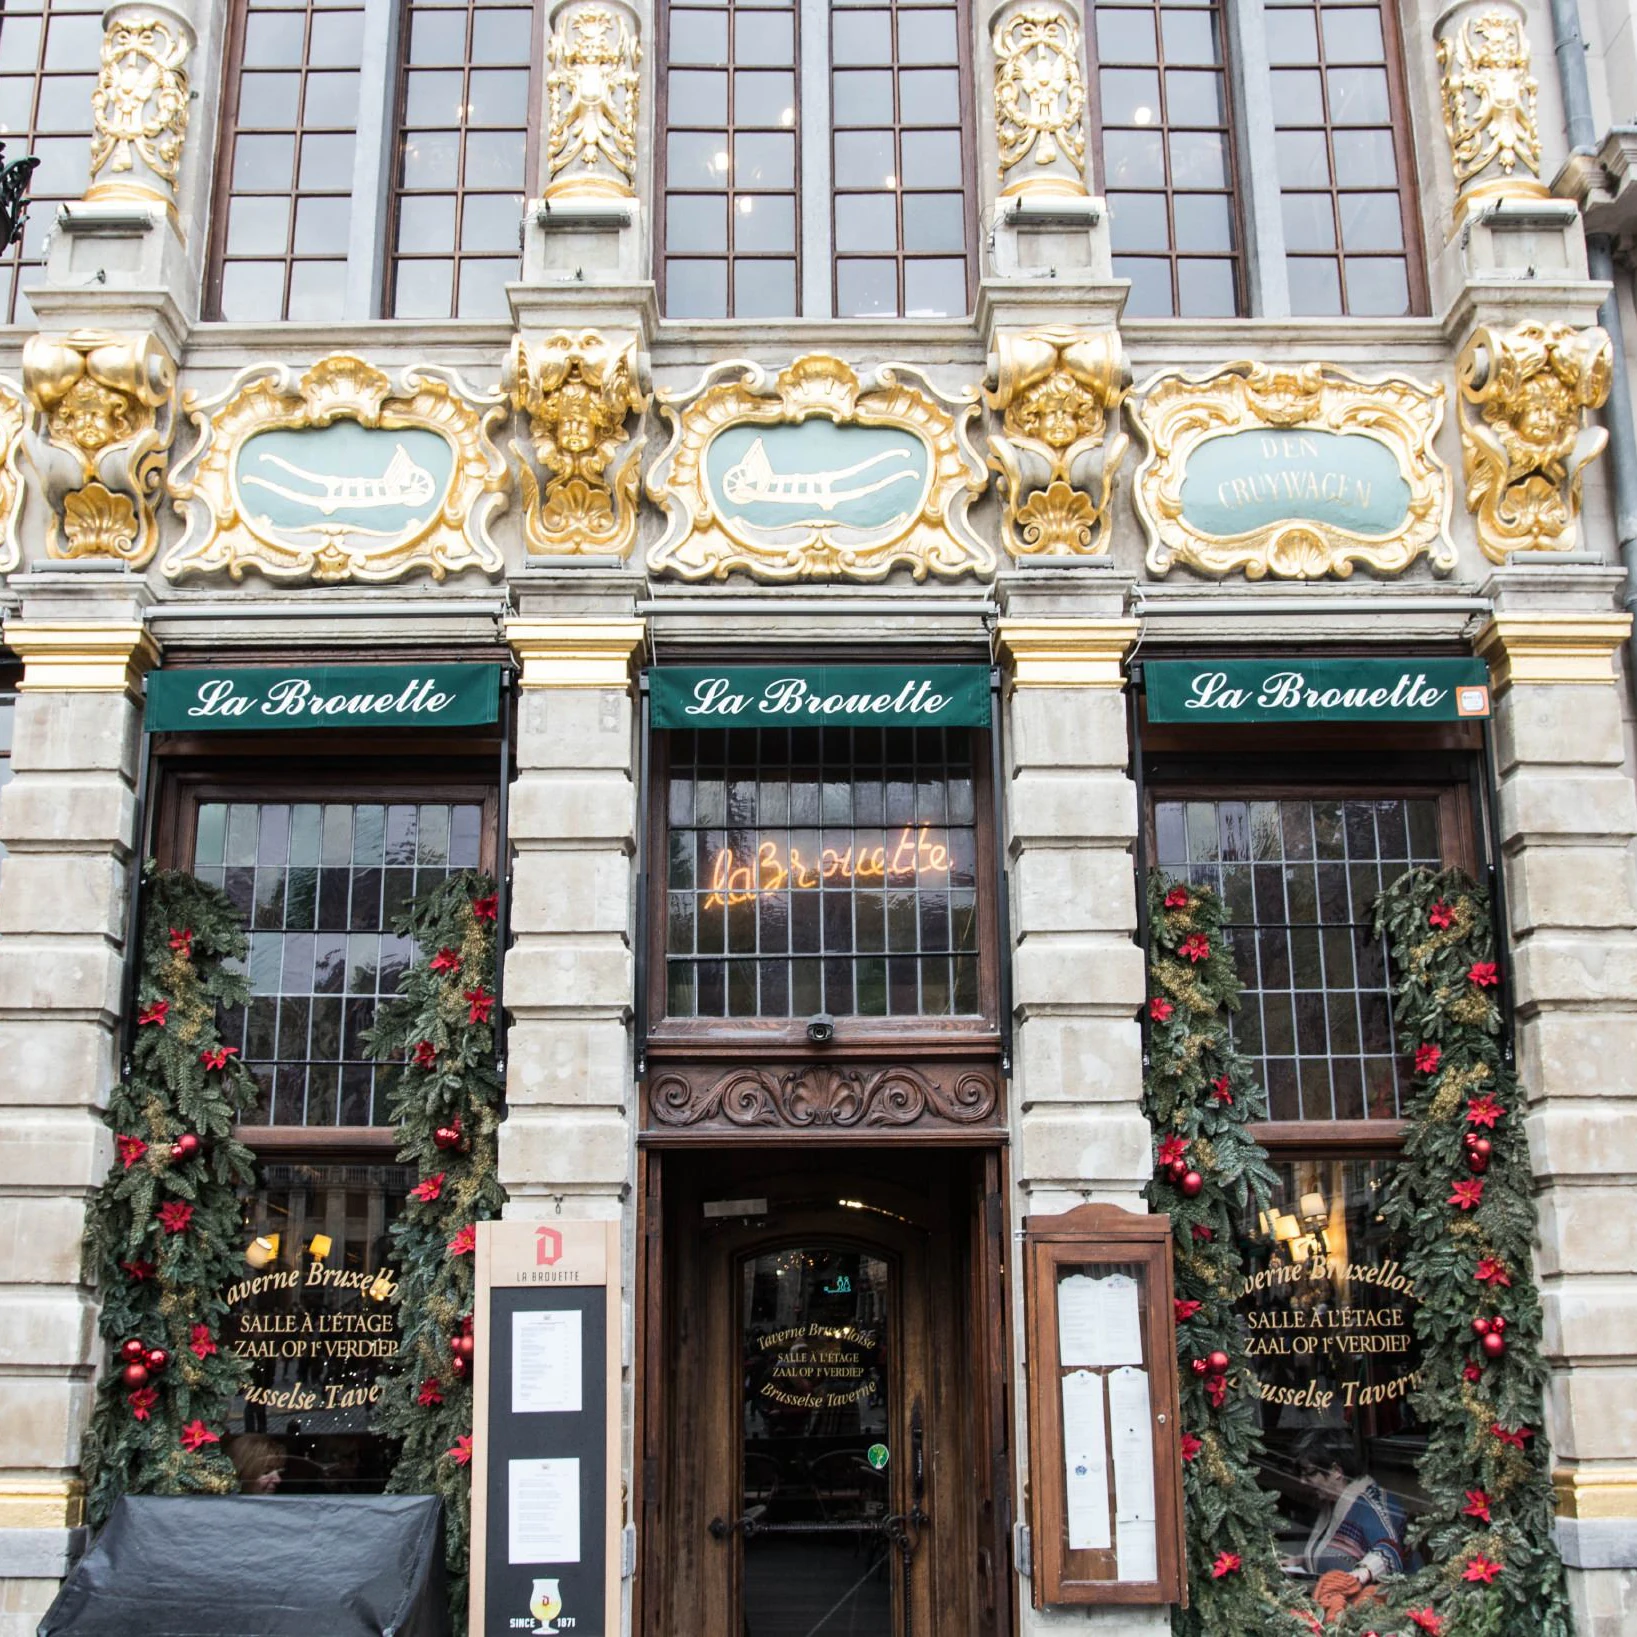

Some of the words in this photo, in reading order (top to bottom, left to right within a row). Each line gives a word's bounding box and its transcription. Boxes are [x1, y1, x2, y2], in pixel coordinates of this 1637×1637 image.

[1261, 436, 1319, 459] DEN
[1218, 471, 1372, 511] CRUYWAGEN
[188, 680, 258, 716] La
[261, 679, 455, 715] Brouette
[685, 678, 754, 714] La
[758, 678, 953, 714] Brouette
[1185, 672, 1253, 709] La
[1257, 672, 1447, 708] Brouette
[219, 1269, 300, 1306] averne
[305, 1262, 399, 1298] Bruxello
[516, 1272, 527, 1282] LA
[532, 1271, 580, 1282] BROUETTE
[1240, 1263, 1303, 1298] verne
[240, 1314, 297, 1333] SALLE
[301, 1312, 314, 1333] À
[1247, 1311, 1306, 1329] SALLE
[234, 1340, 279, 1358] ZAAL
[281, 1340, 307, 1358] OP
[323, 1339, 399, 1358] VERDIEP
[757, 1326, 806, 1351] Taverne
[1243, 1337, 1291, 1355] ZAAL
[1292, 1336, 1318, 1354] OP
[1334, 1335, 1412, 1353] VERDIEP
[778, 1352, 807, 1363] SALLE
[772, 1367, 799, 1378] ZAAL
[799, 1367, 814, 1378] OP
[823, 1367, 865, 1378] VERDIEP
[242, 1381, 317, 1411] usselse
[324, 1383, 384, 1410] Tave
[760, 1382, 823, 1408] Brusselse
[826, 1380, 877, 1408] Taverne
[1341, 1370, 1423, 1408] Tavern
[509, 1617, 536, 1629] SINCE
[556, 1617, 576, 1628] 1871
